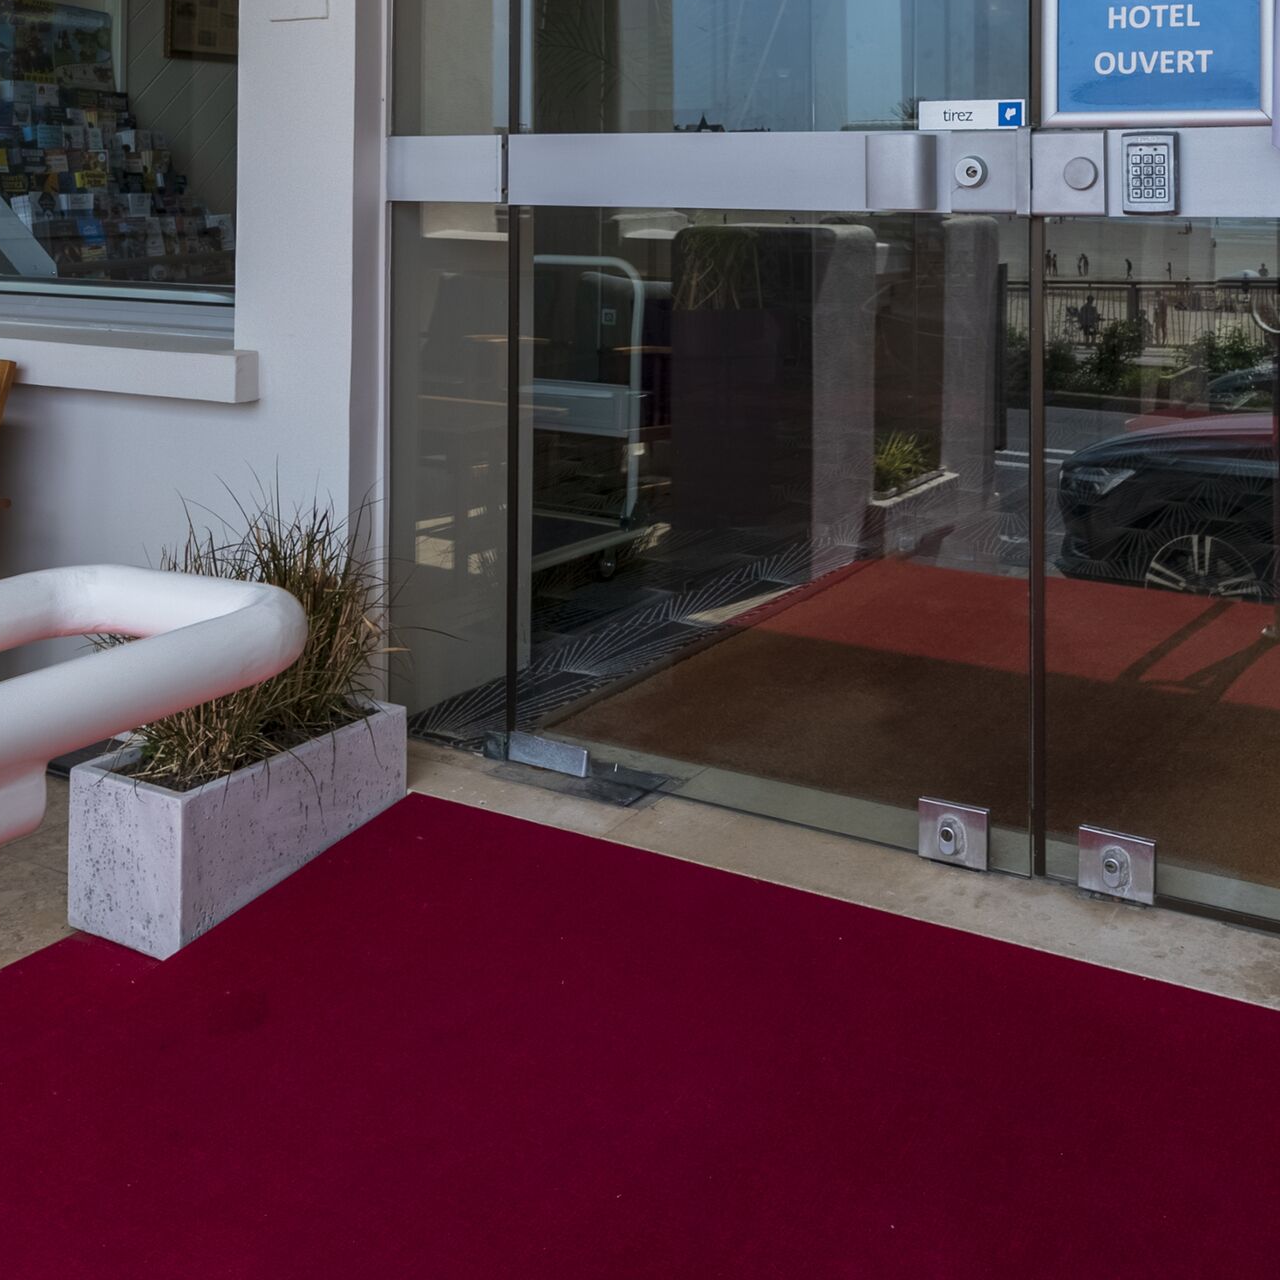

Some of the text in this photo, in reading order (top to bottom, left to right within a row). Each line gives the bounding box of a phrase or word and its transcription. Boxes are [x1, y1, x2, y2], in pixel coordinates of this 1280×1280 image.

[1106, 2, 1202, 31] HOTEL
[1093, 48, 1215, 76] OUVERT
[942, 108, 974, 123] tirez
